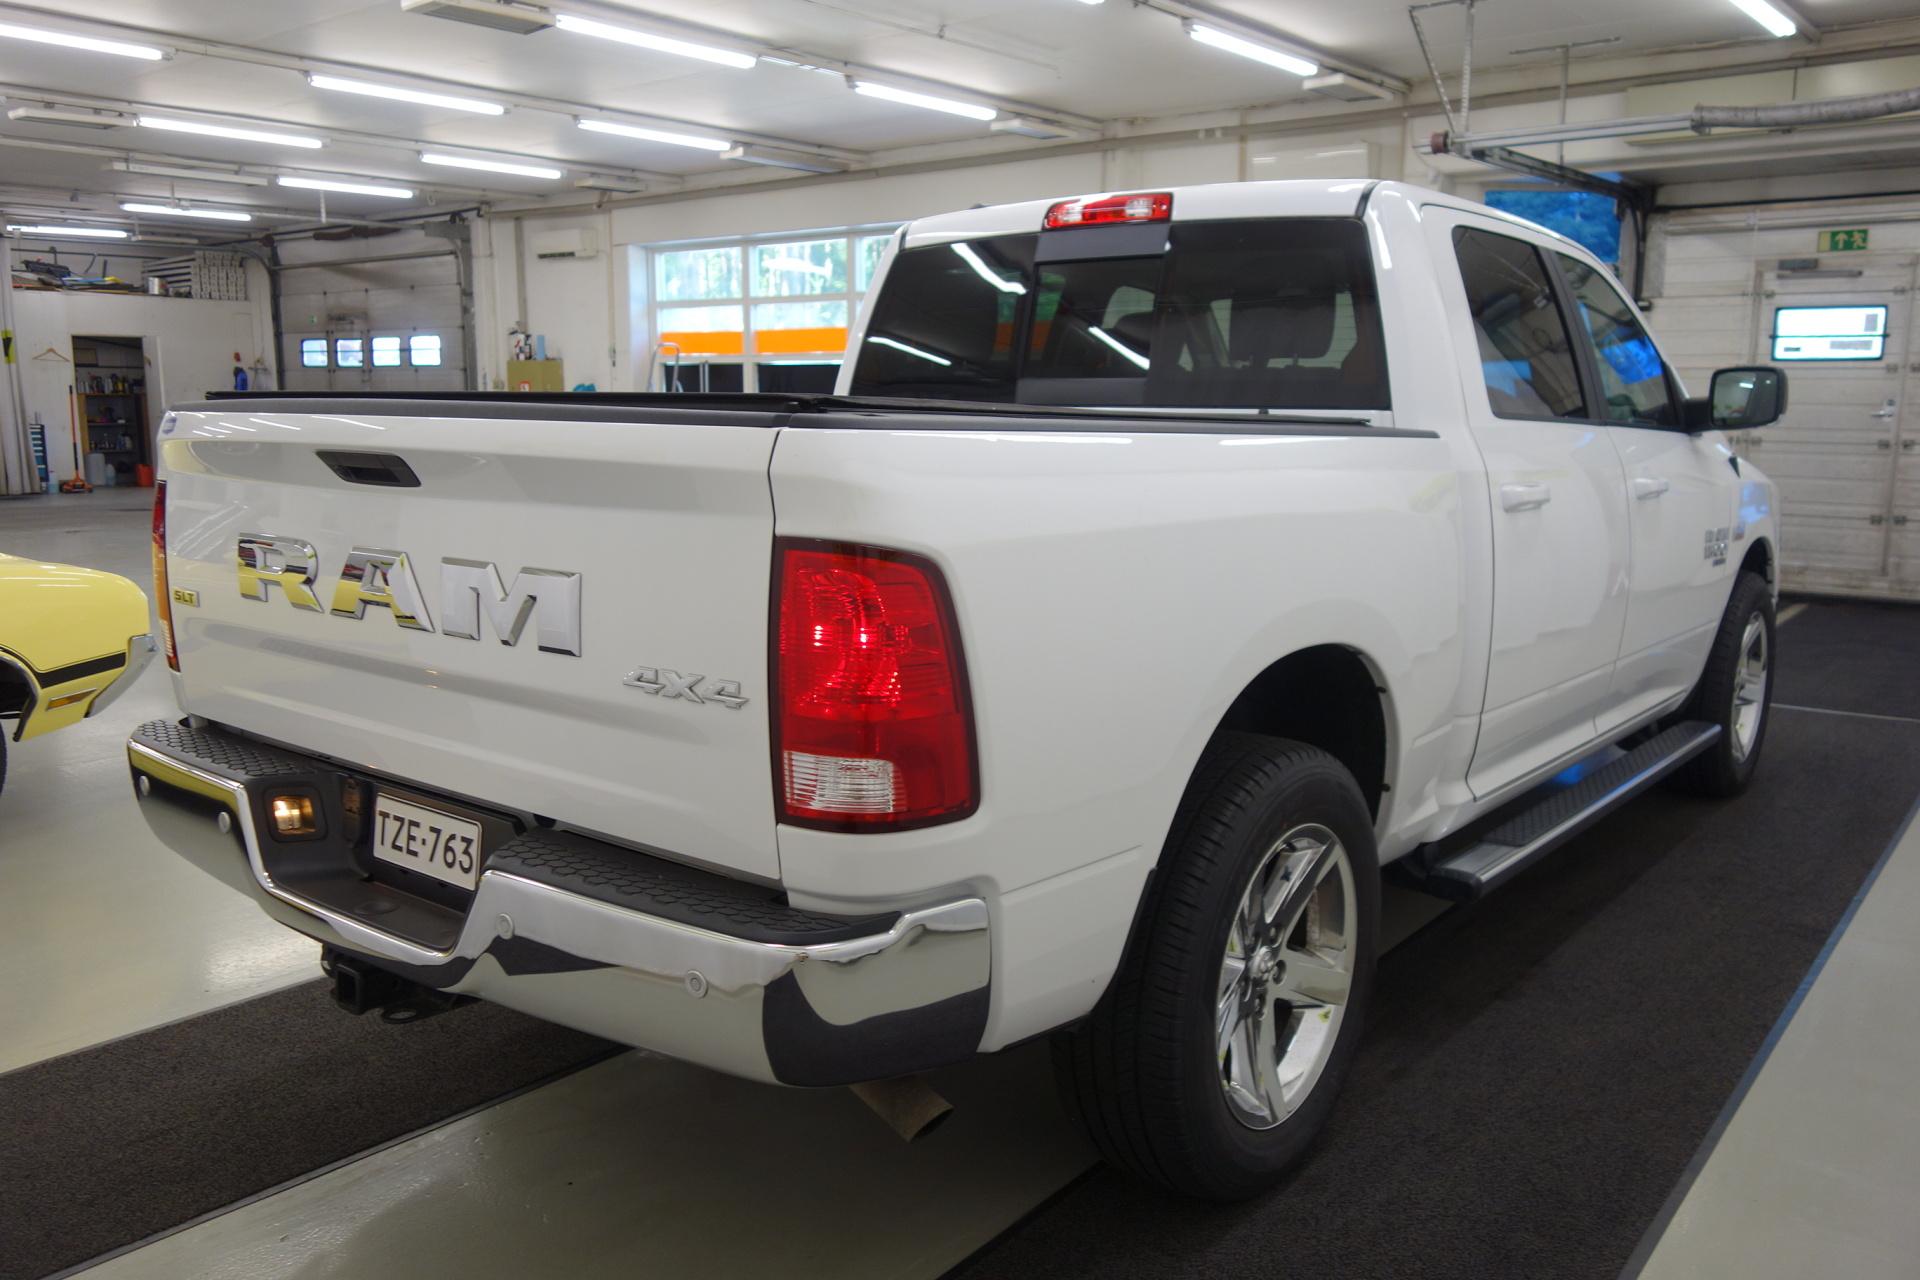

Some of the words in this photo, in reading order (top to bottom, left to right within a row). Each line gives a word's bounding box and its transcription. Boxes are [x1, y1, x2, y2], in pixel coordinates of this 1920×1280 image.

[173, 590, 195, 604] SLT
[238, 532, 582, 658] RAM
[378, 810, 474, 874] TZE-763
